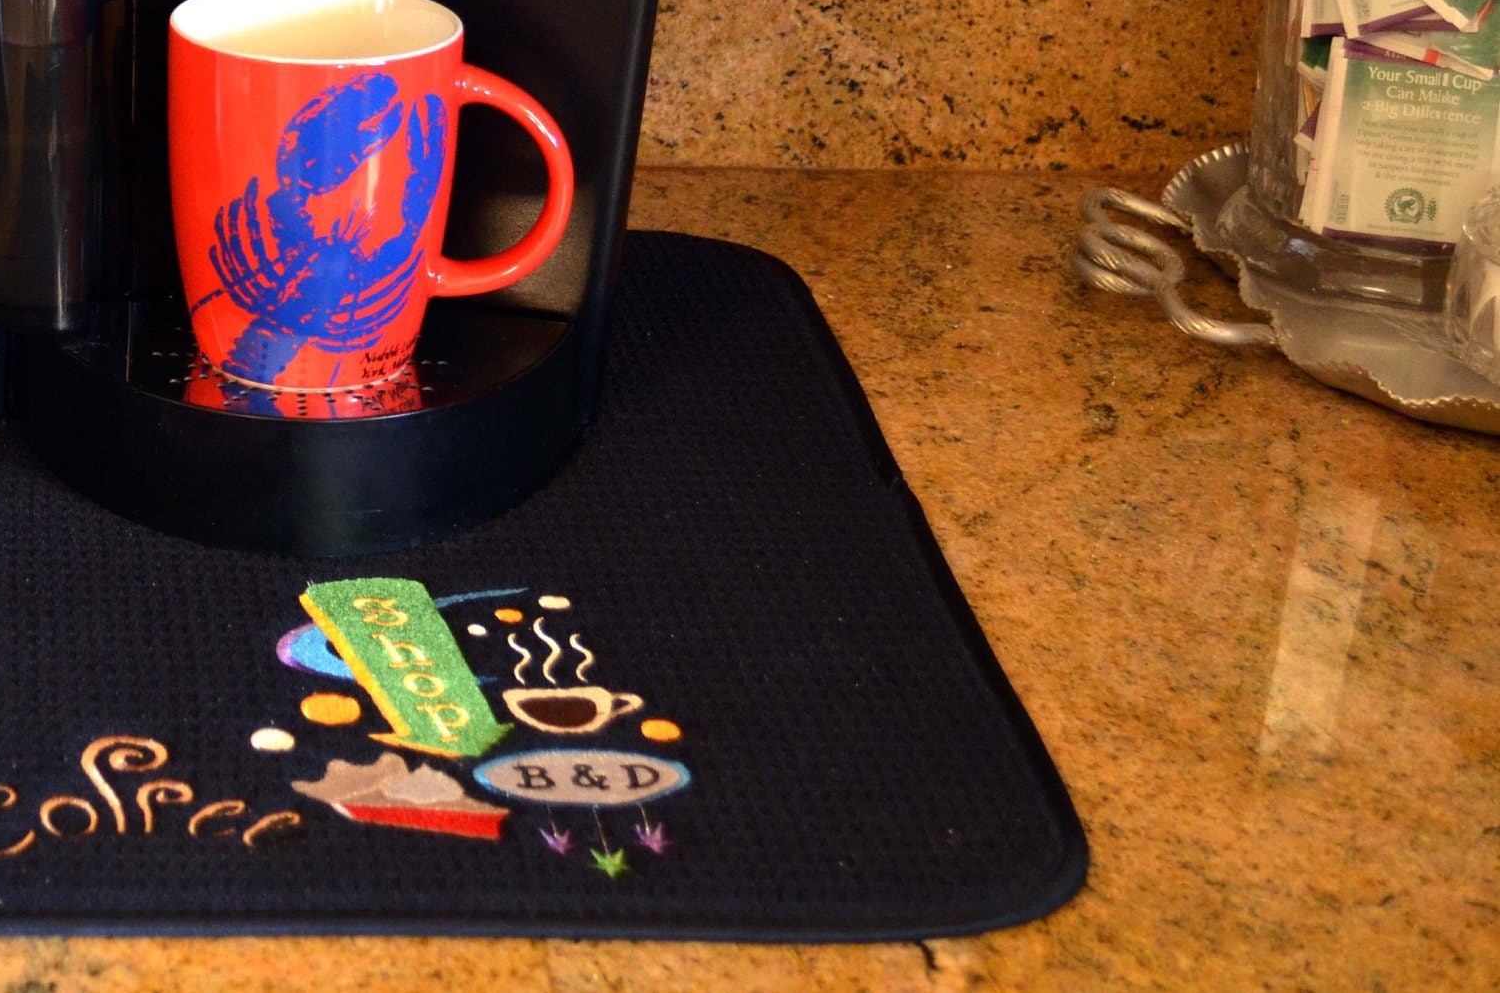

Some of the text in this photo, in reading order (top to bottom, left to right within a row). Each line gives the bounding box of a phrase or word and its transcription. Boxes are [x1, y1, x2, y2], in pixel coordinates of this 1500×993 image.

[1368, 66, 1482, 95] Your Small Cup
[1362, 100, 1371, 112] a
[1375, 99, 1398, 119] Big
[1386, 85, 1461, 105] Can Make
[353, 594, 471, 745] Shop
[512, 762, 663, 790] B & D
